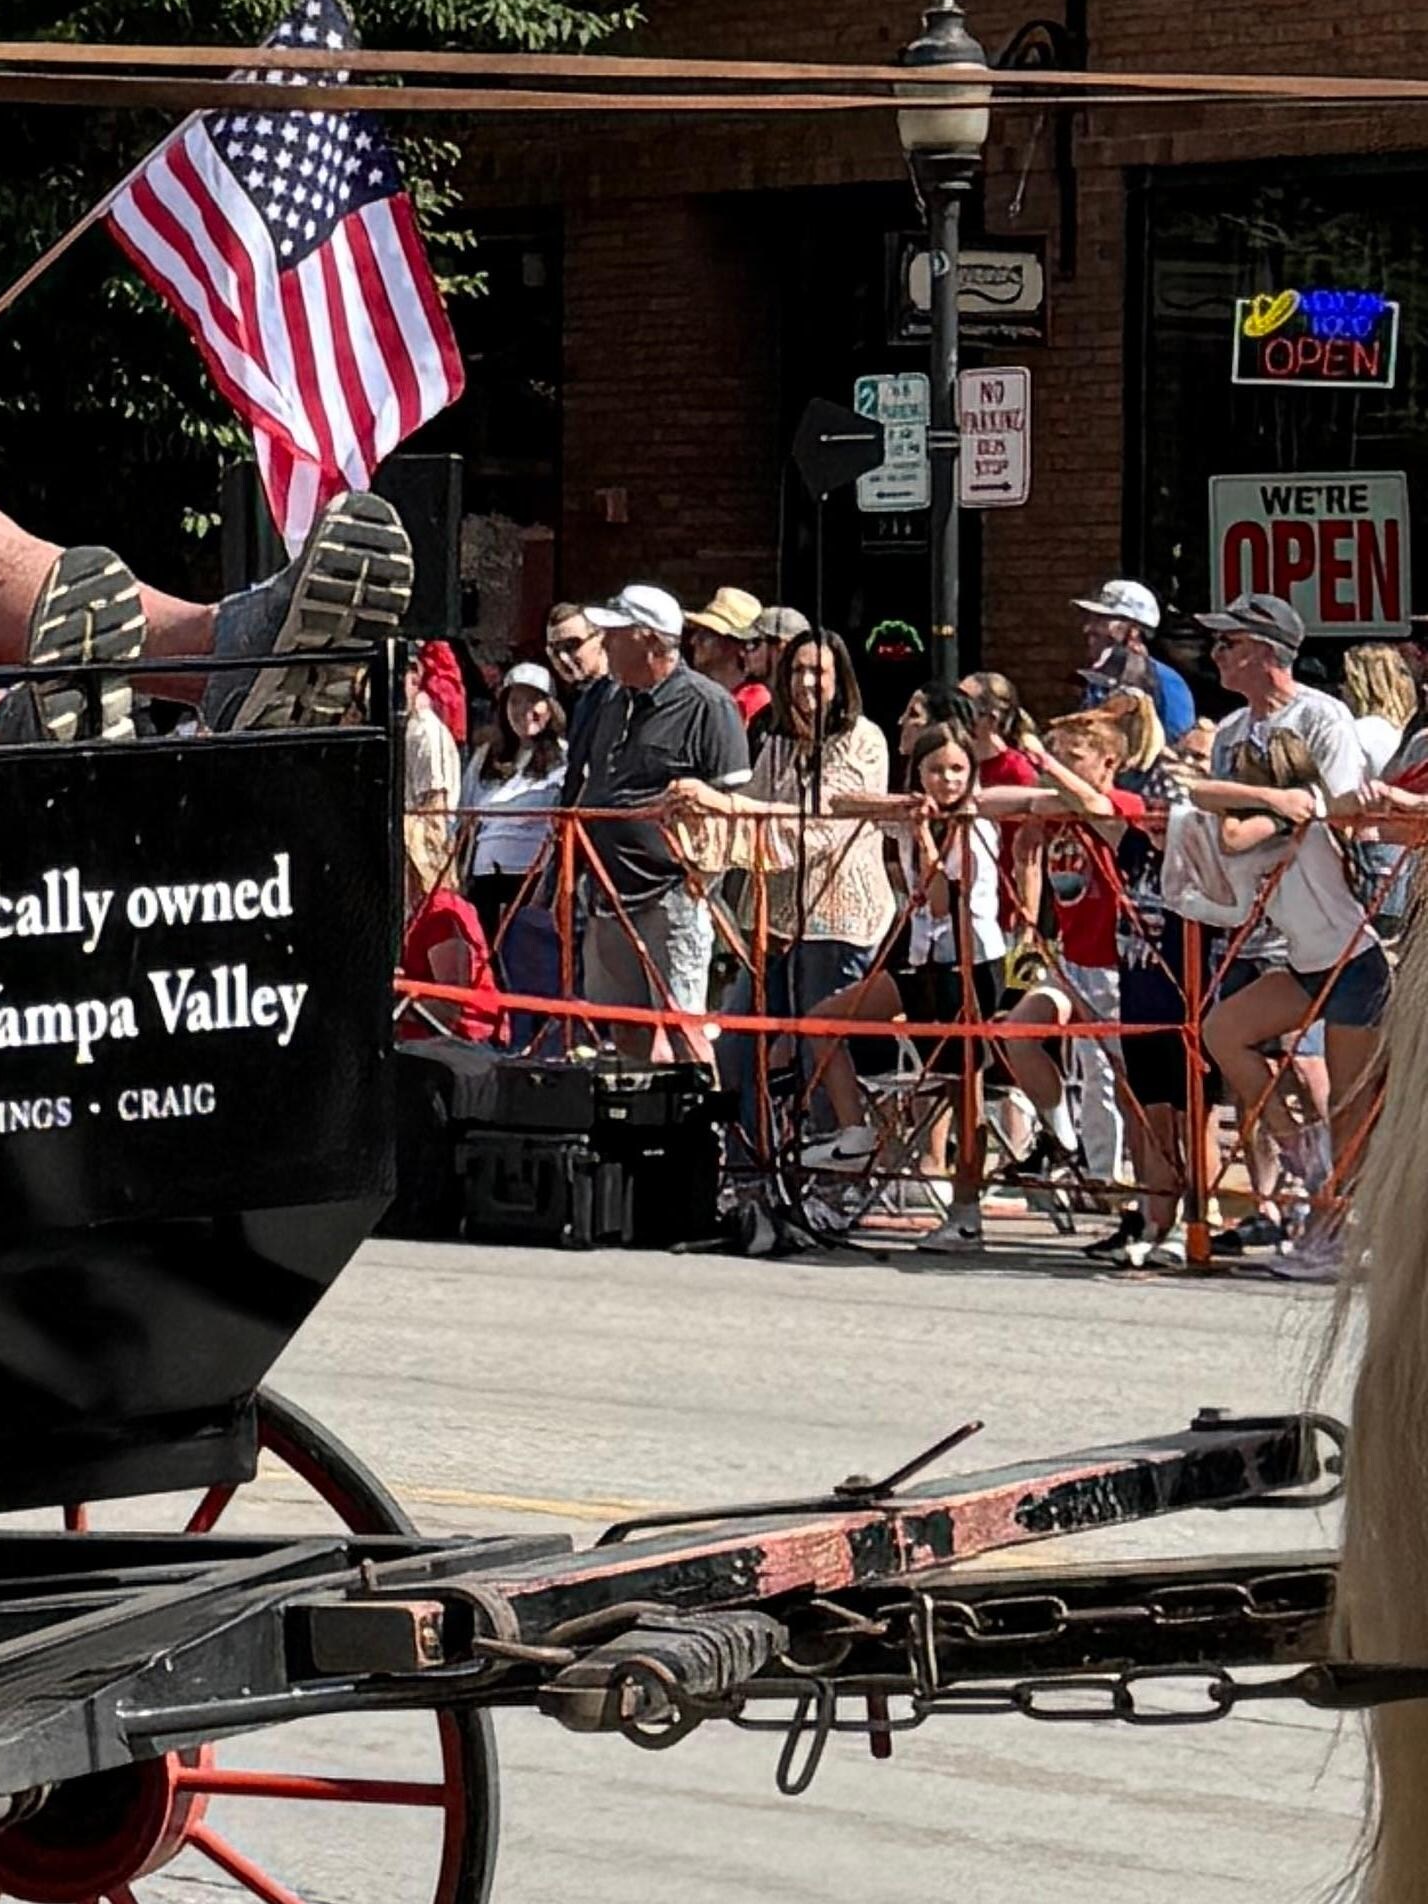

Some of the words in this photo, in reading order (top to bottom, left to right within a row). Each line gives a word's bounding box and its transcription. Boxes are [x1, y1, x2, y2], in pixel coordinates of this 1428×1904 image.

[1265, 337, 1381, 377] OPEN
[981, 380, 1005, 404] NO
[1260, 483, 1369, 516] WE'RE
[1223, 518, 1402, 623] OPEN
[126, 852, 293, 929] owned
[148, 963, 308, 1048] Valley
[117, 1083, 216, 1122] CRAIG
